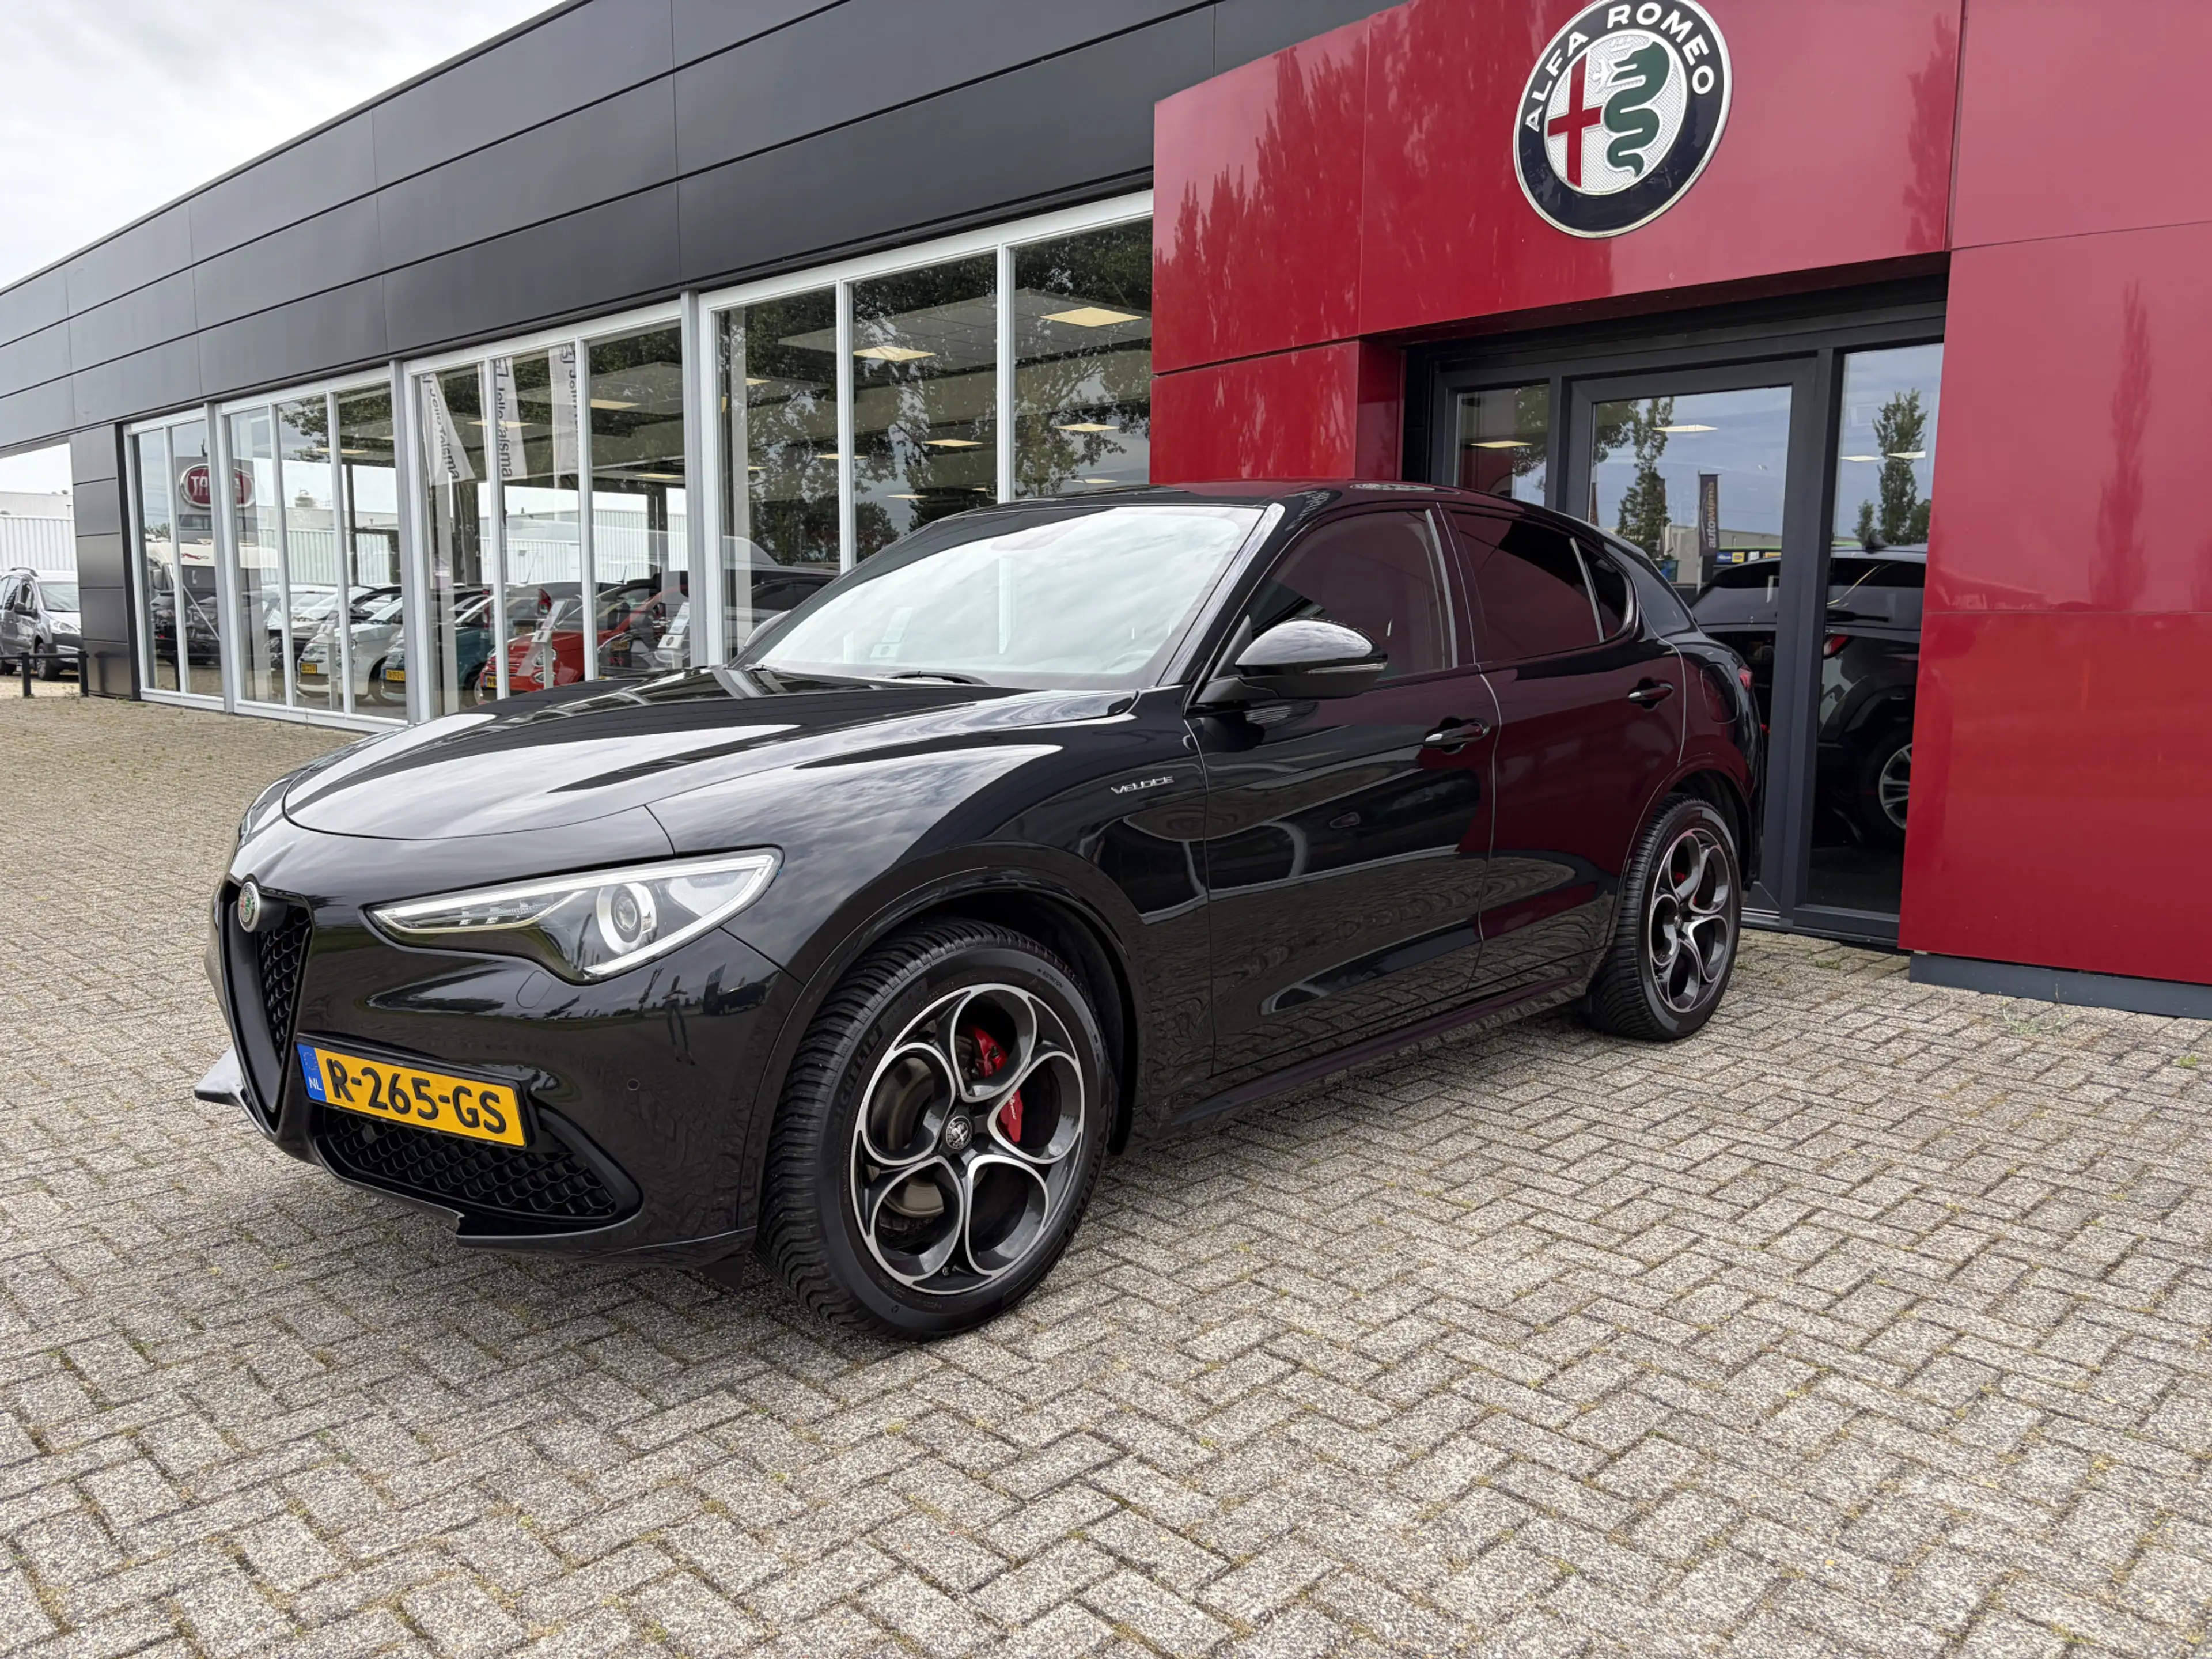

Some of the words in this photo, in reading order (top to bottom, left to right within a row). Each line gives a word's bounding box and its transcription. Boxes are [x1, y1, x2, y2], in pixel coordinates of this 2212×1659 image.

[1525, 31, 1589, 133] ALFA
[1607, 2, 1715, 96] ROMEO
[1110, 775, 1175, 795] VELOCE
[308, 1075, 323, 1091] NL
[325, 1058, 507, 1134] R-265-GS
